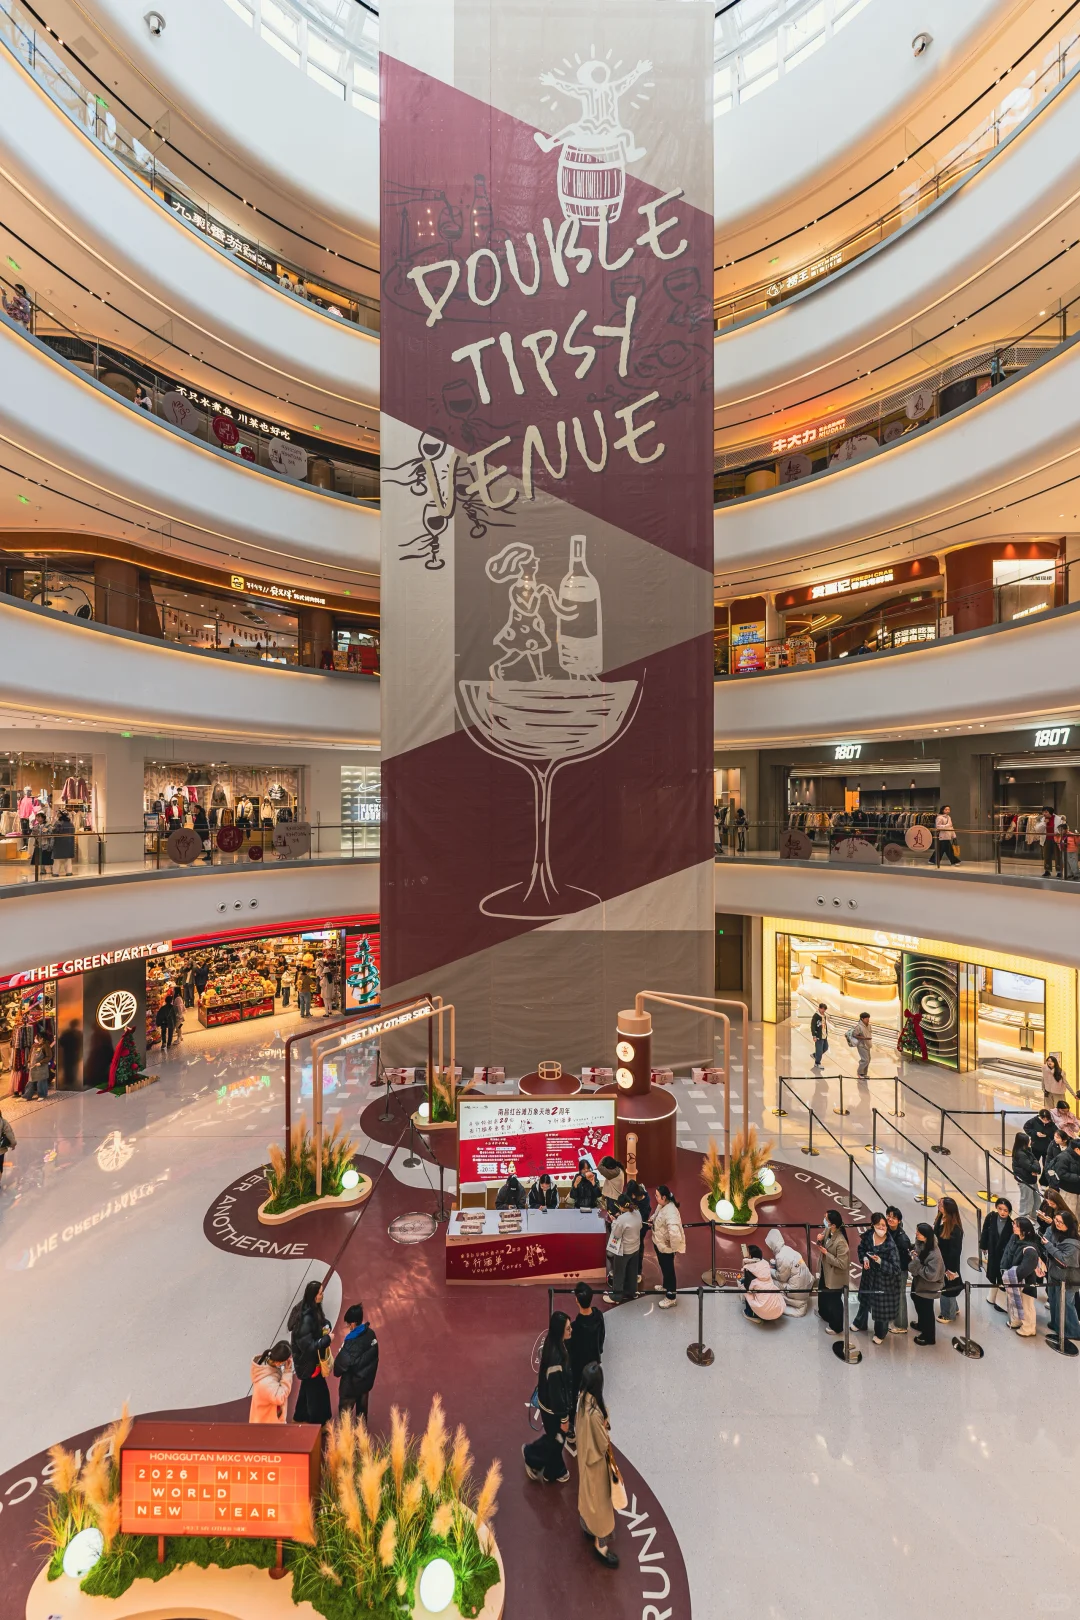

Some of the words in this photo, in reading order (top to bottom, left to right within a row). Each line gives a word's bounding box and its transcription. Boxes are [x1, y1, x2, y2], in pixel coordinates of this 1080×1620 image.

[407, 187, 688, 327] DOUBLE
[451, 296, 636, 404] TIPSY
[175, 385, 233, 419] 不只水煮鱼
[238, 413, 291, 441] 川菜也好吃
[772, 429, 817, 451] 牛大力
[423, 391, 666, 518] VENUE
[851, 574, 873, 582] FRESH
[874, 569, 894, 578] CRAB
[1034, 727, 1071, 747] 1807
[834, 745, 862, 760] 1807
[28, 963, 58, 982] THE
[62, 952, 111, 974] GREEN
[114, 943, 156, 963] PARTY
[340, 1028, 367, 1045] MEET
[367, 1023, 383, 1034] MY
[384, 1012, 413, 1029] OTHER
[412, 1006, 431, 1019] SIDE
[150, 1452, 214, 1462] HONGGUTAN
[216, 1454, 241, 1462] MIXC
[243, 1455, 282, 1463] WORLD
[138, 1469, 188, 1479] 2026
[217, 1471, 276, 1481] MIXC
[152, 1487, 228, 1499] WORLD
[137, 1506, 182, 1516] NEW
[218, 1507, 276, 1518] YEAR
